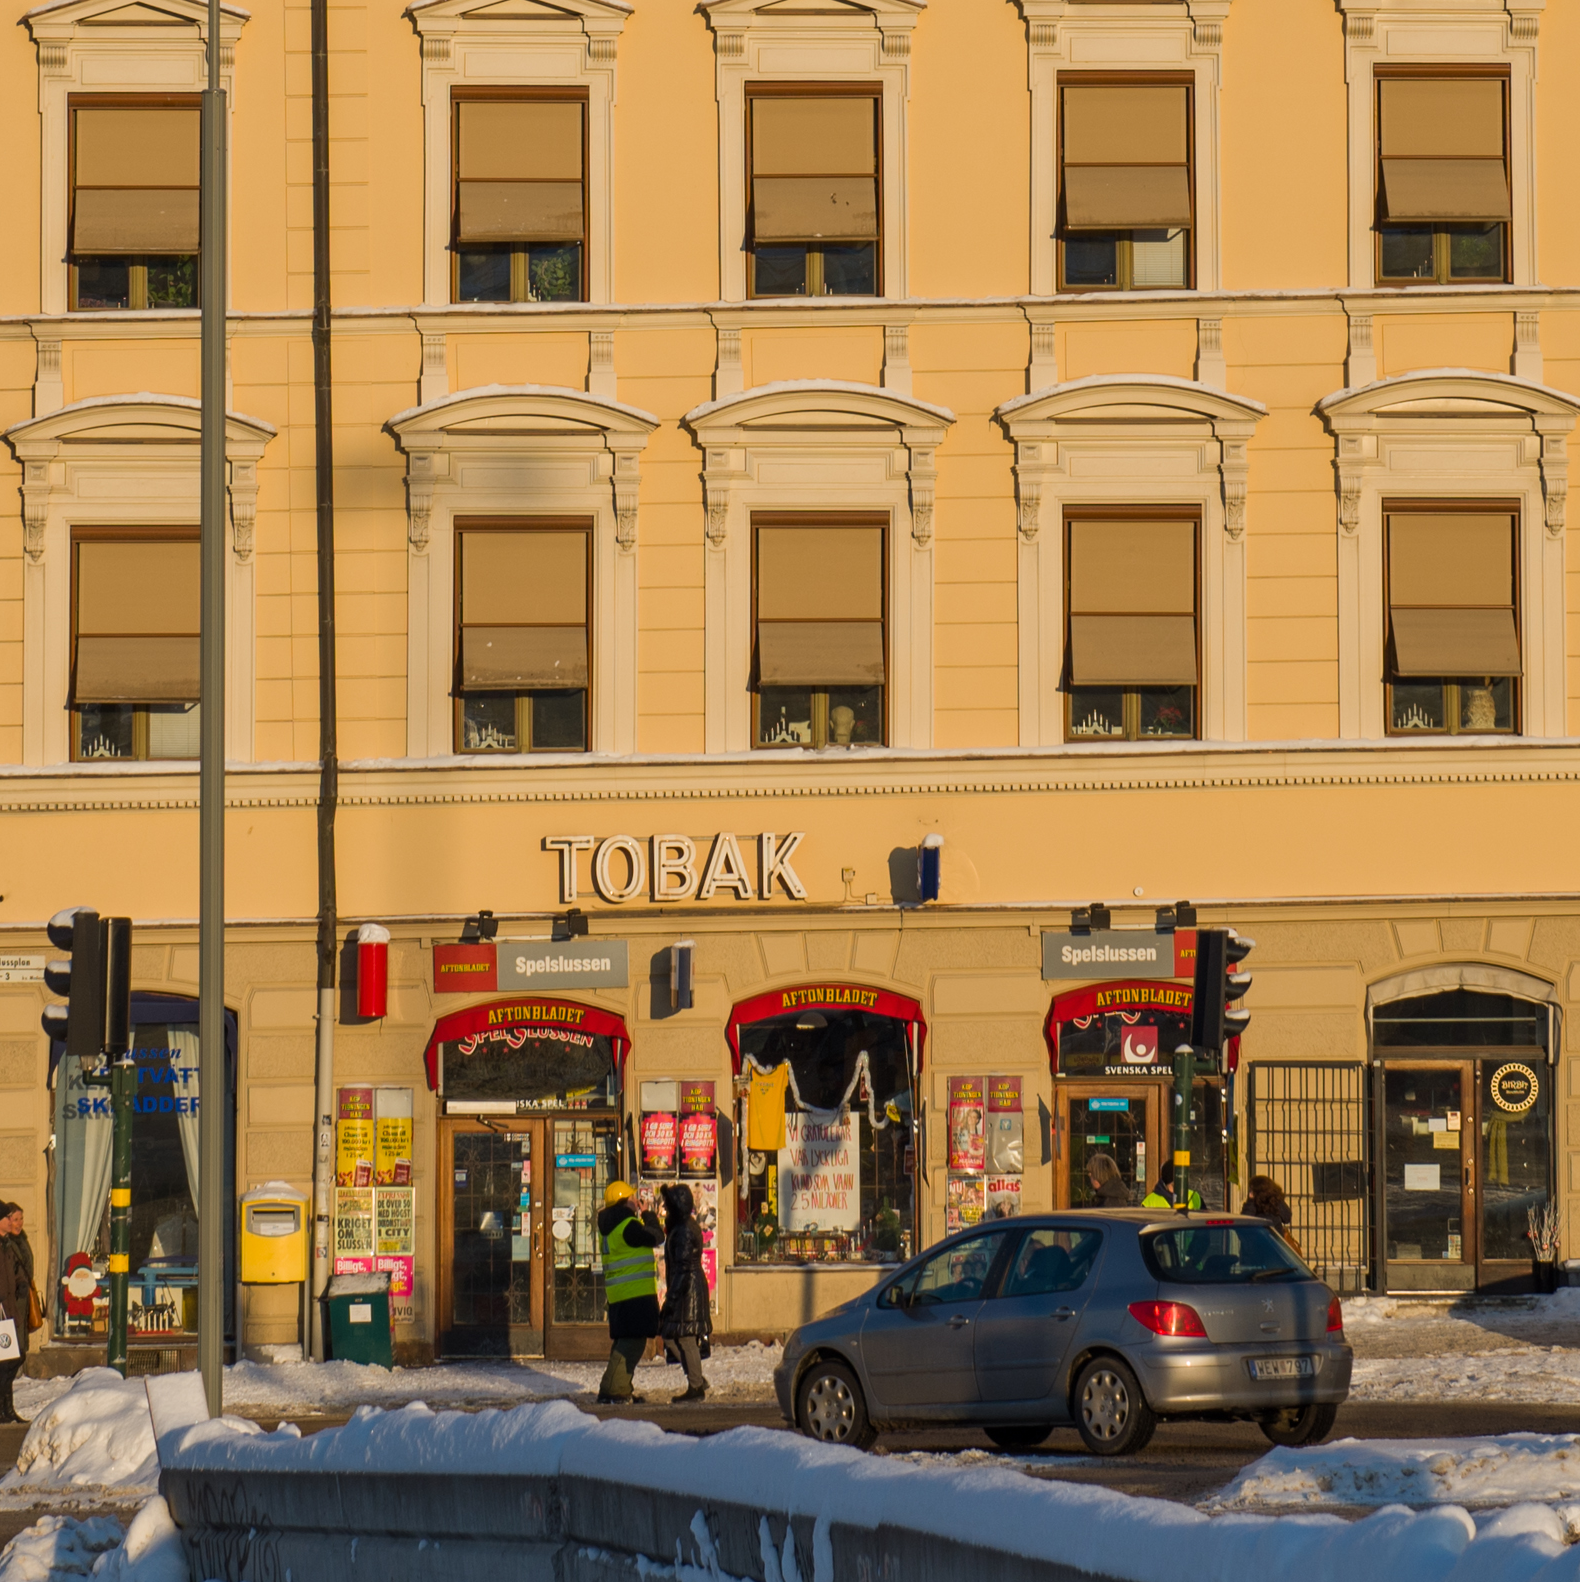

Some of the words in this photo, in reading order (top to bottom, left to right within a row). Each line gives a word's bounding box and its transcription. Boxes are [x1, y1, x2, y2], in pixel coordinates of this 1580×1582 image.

[542, 831, 808, 903] TOBAK
[1061, 945, 1157, 966] Spelslussen
[440, 963, 490, 973] AFTONBLADET
[515, 955, 611, 976] Spelslussen
[782, 987, 878, 1008] AFTONBLADET
[1096, 988, 1193, 1008] AFTONBLADET
[487, 1005, 585, 1025] AFTONBLADET
[1105, 1066, 1148, 1075] SVENSKA
[1151, 1066, 1173, 1075] SPEL
[541, 1099, 564, 1108] SPEL
[788, 1123, 798, 1142] VI
[811, 1148, 849, 1167] LYCKLIGA
[791, 1173, 813, 1191] KUND
[813, 1173, 830, 1191] SOM
[832, 1173, 854, 1191] VANN
[988, 1179, 1020, 1193] allas
[378, 1200, 385, 1208] DE
[337, 1219, 372, 1229] KRIGET
[337, 1229, 355, 1239] OM
[385, 1228, 410, 1237] CITY
[337, 1240, 372, 1250] SLUSSEN
[337, 1260, 367, 1273] Billigt,
[378, 1259, 407, 1270] Billigt,
[1286, 1359, 1308, 1373] 797
